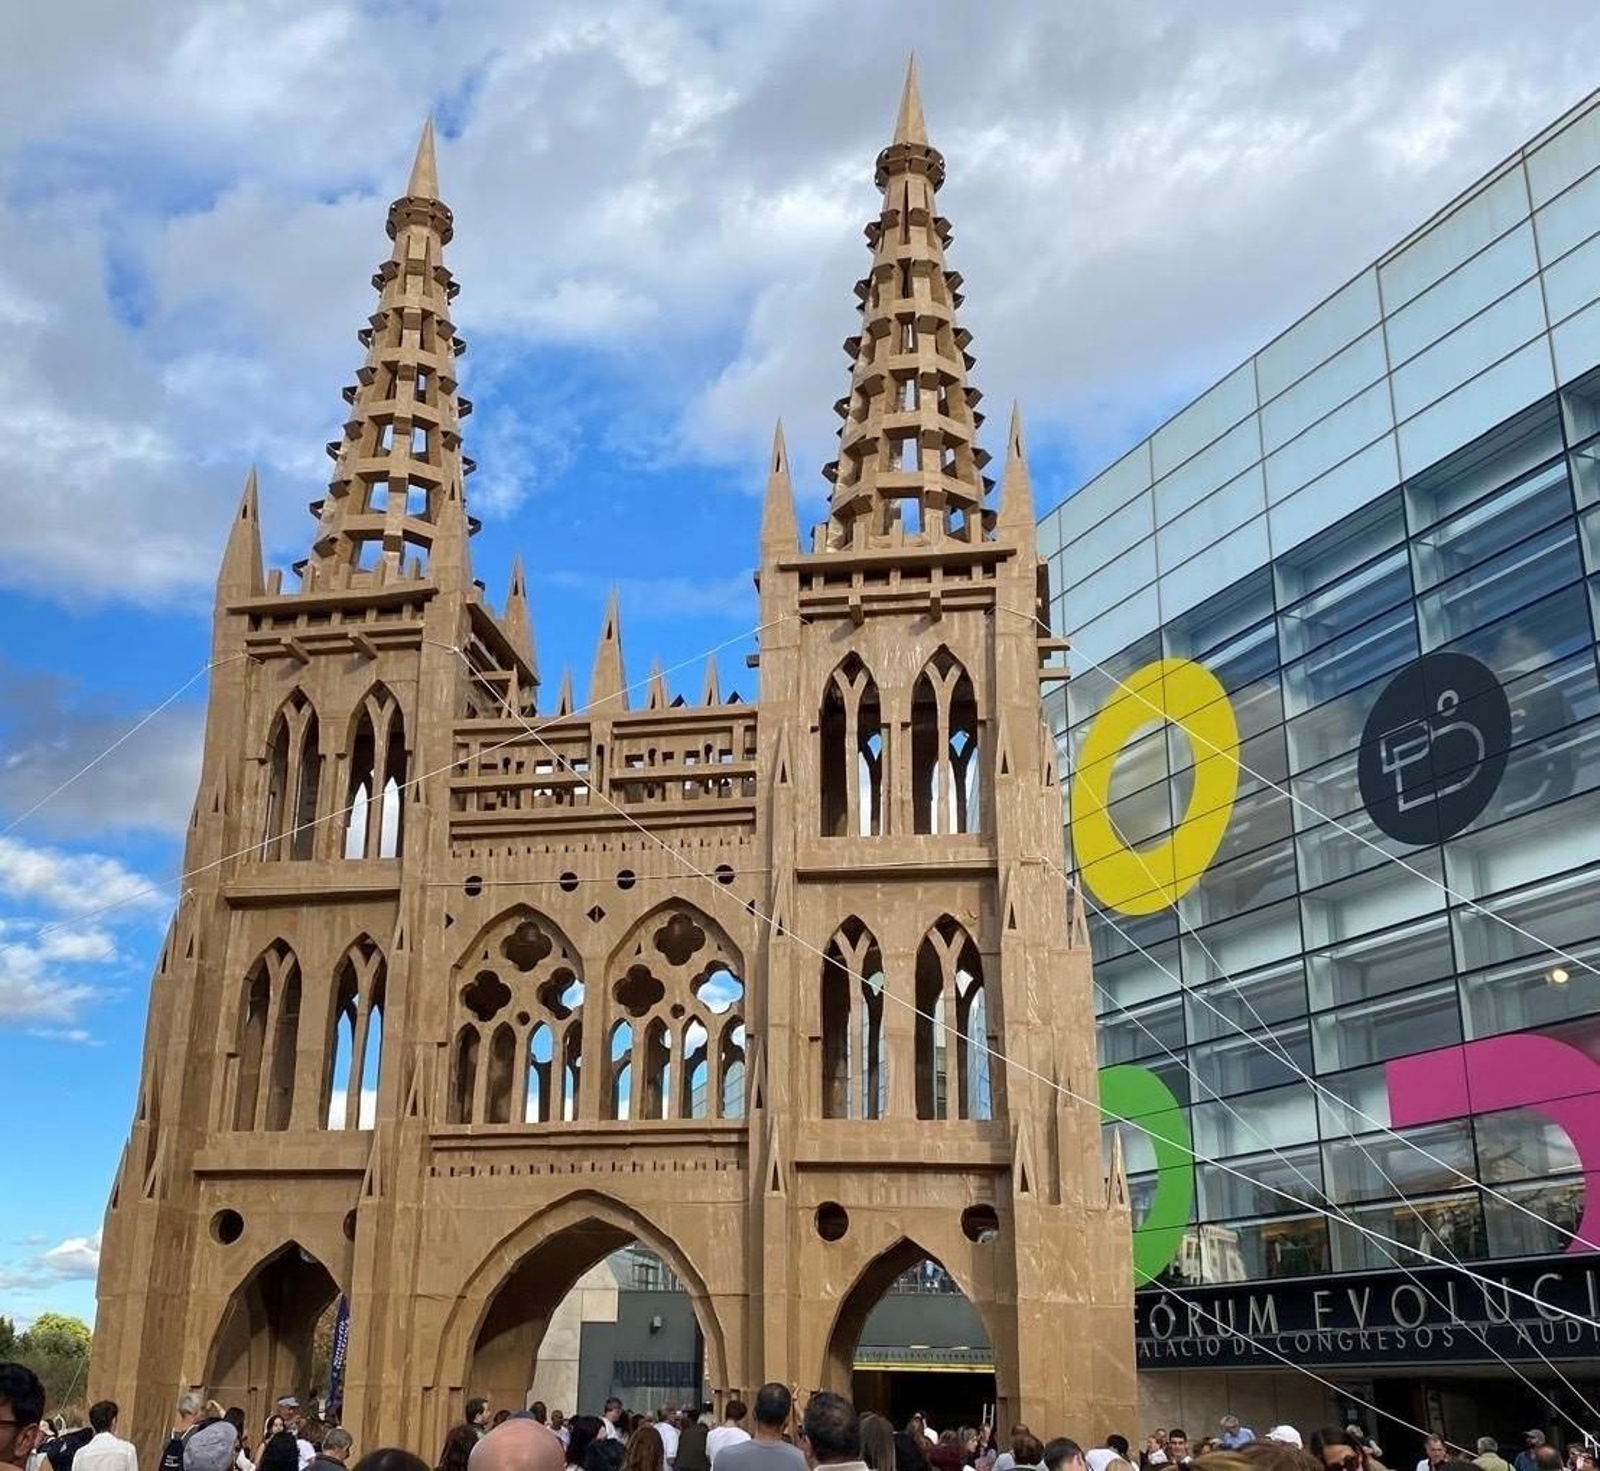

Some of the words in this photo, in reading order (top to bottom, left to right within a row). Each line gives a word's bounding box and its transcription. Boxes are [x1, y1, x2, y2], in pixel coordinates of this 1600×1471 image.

[1134, 1294, 1277, 1339] ÓRUM
[1313, 1270, 1597, 1331] EVOLUCI
[1139, 1337, 1220, 1357] ALACIO
[1234, 1337, 1260, 1355] DE
[1276, 1322, 1454, 1353] CONGRESOS
[1477, 1323, 1489, 1342] Y
